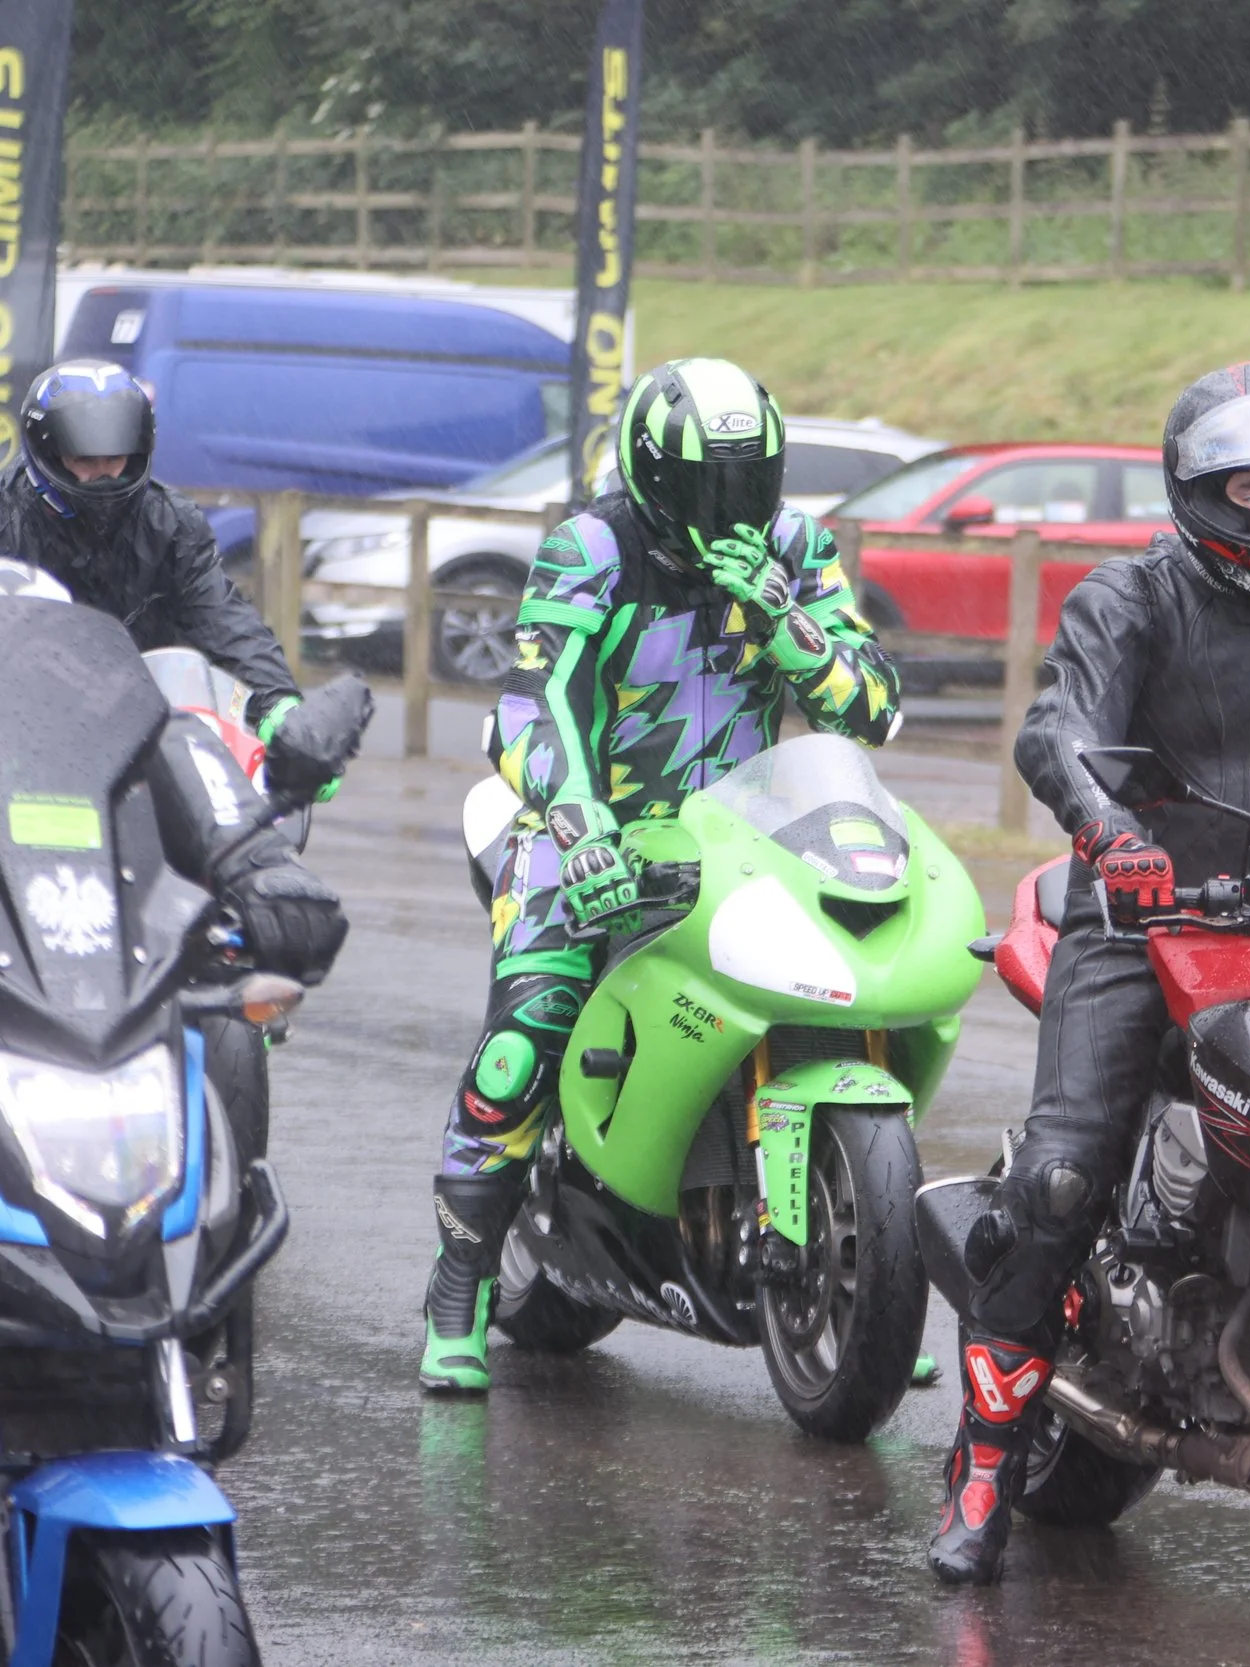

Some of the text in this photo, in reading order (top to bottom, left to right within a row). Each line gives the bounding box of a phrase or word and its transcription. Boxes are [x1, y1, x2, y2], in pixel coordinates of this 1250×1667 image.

[584, 313, 623, 416] NO
[716, 415, 753, 431] X-lite
[1091, 786, 1111, 809] SOUL
[794, 982, 817, 995] SPEED
[818, 987, 829, 997] UP
[528, 1000, 577, 1017] RST
[669, 1013, 704, 1043] Ninja
[789, 1122, 805, 1225] PIRELLI
[433, 1195, 482, 1243] RST
